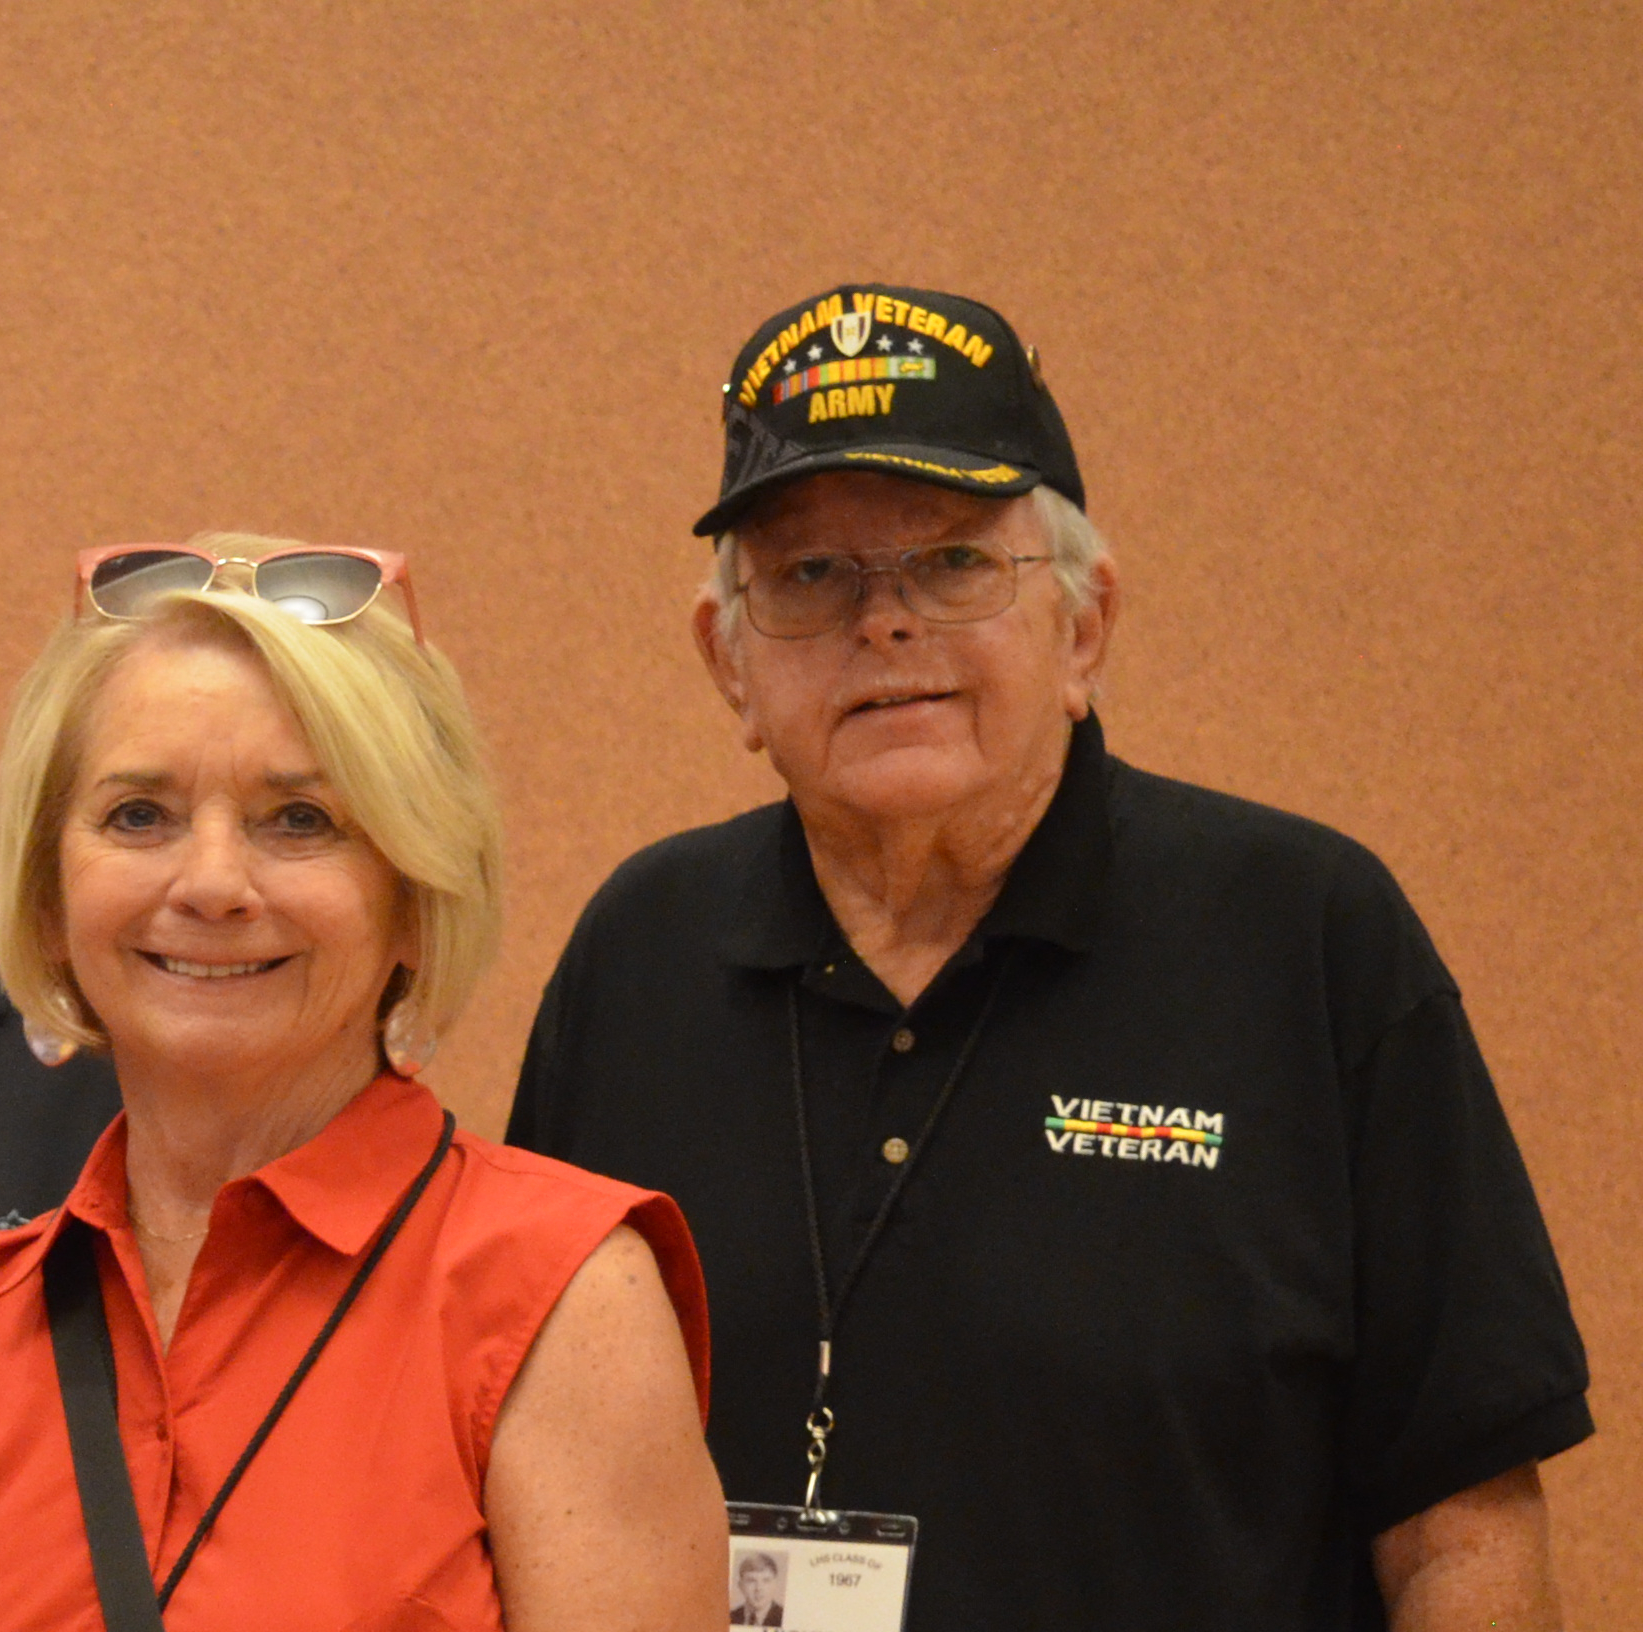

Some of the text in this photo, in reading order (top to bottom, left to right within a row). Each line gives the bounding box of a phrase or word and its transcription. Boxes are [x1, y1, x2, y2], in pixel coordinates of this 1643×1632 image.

[738, 292, 995, 409] VIETNAM VETERAN
[808, 383, 896, 425] ARMY
[1051, 1094, 1225, 1135] VIETNAM
[1045, 1129, 1220, 1170] VETERAN
[828, 1571, 862, 1588] 1967
